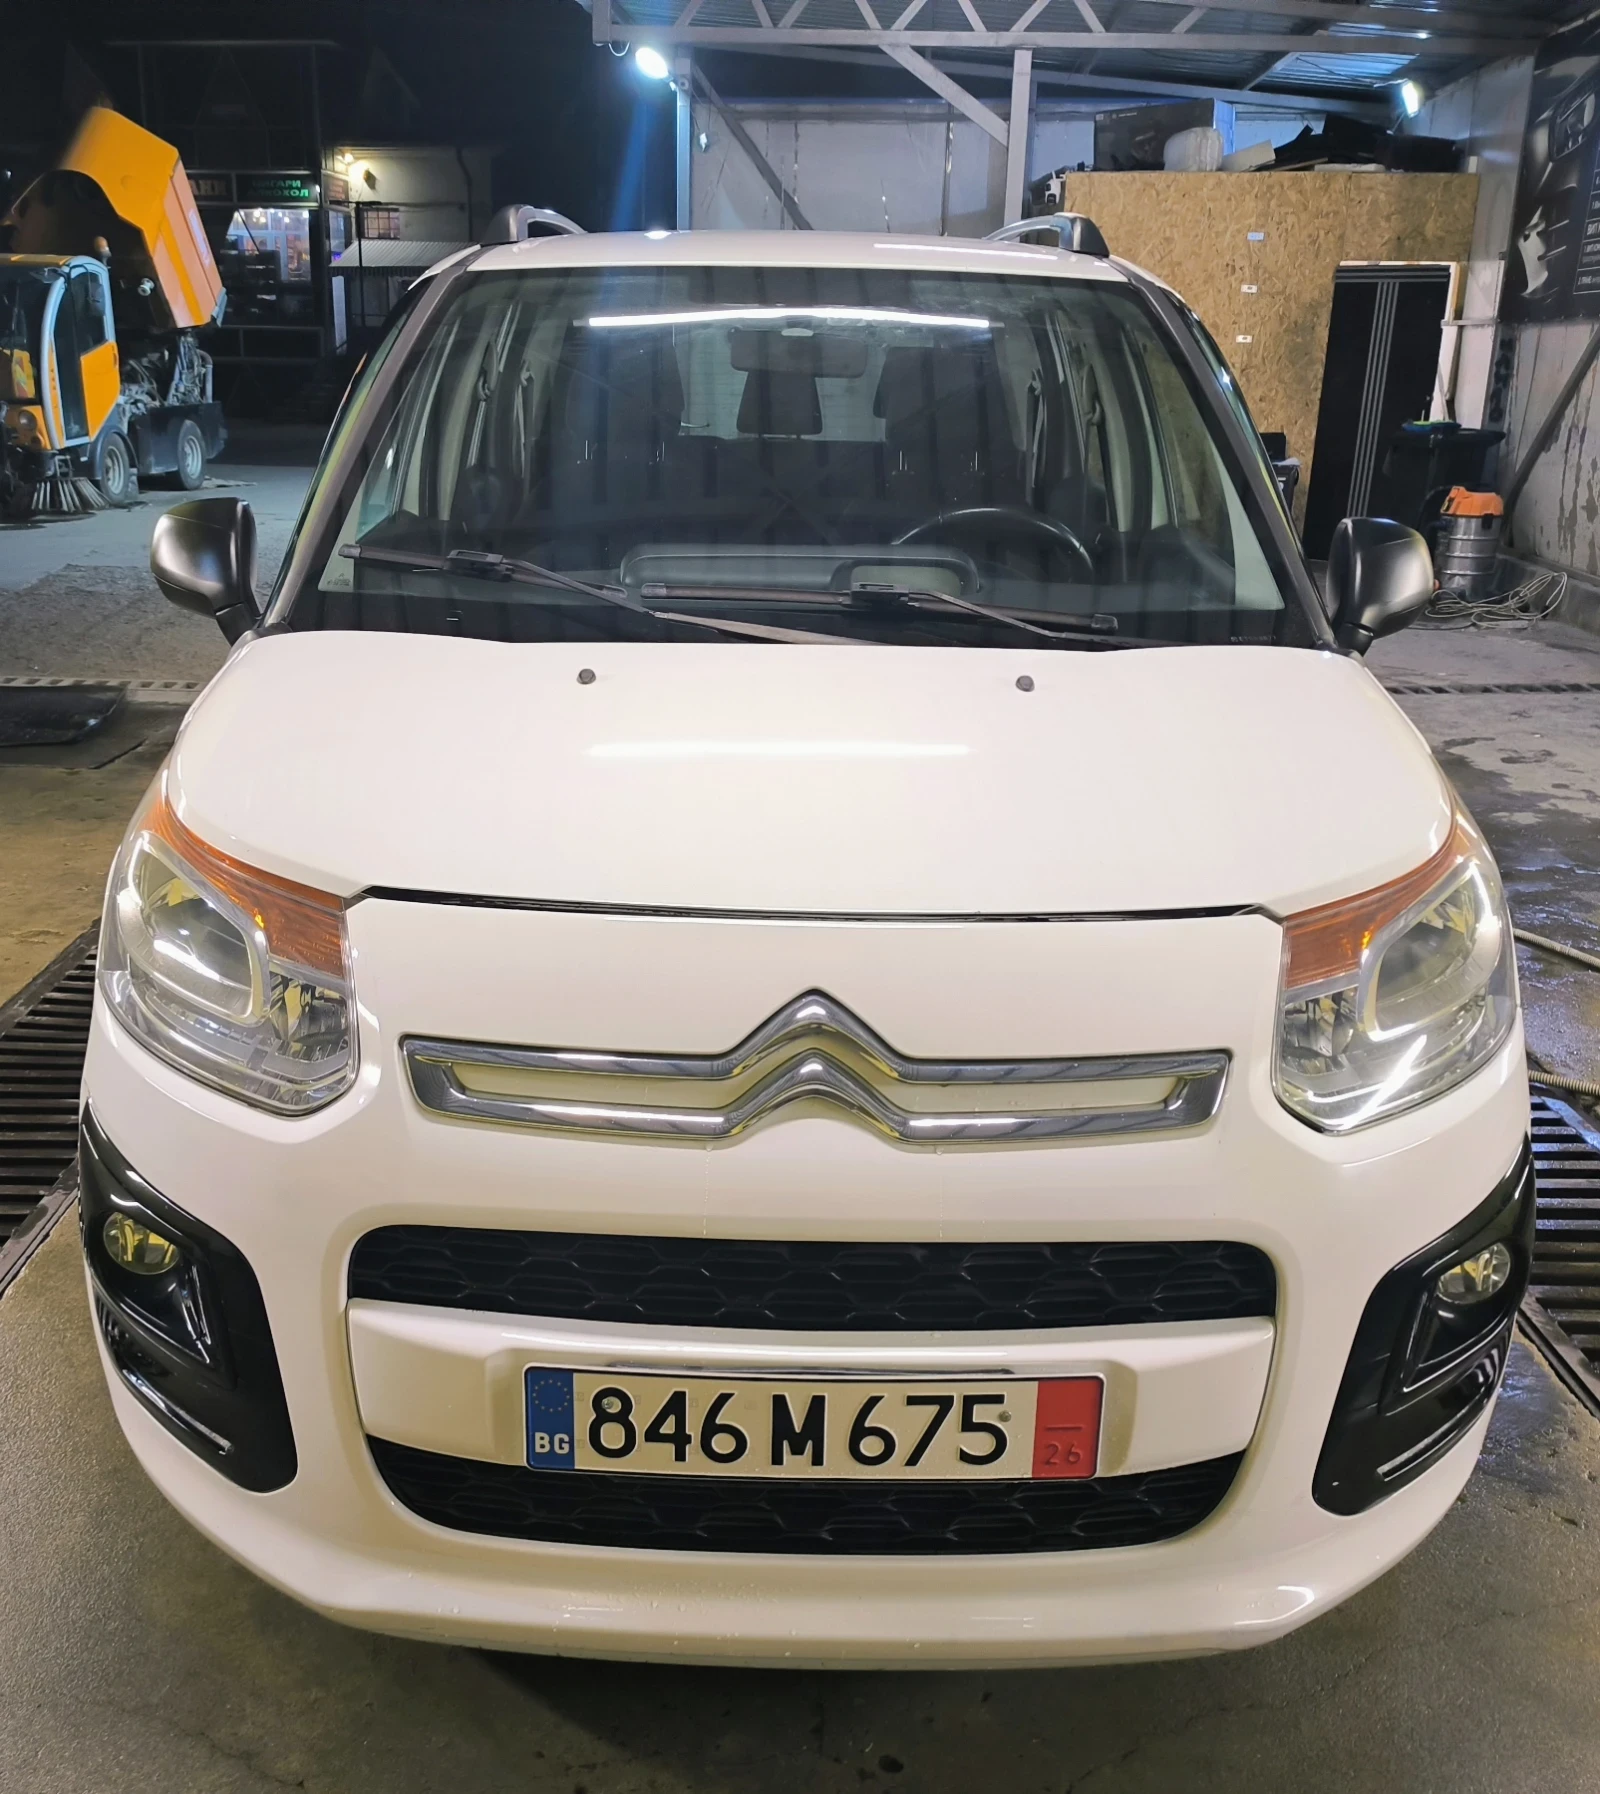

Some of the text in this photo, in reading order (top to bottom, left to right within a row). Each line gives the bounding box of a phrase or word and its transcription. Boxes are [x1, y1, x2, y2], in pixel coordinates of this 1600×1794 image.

[589, 1386, 1008, 1467] 846 M 675
[535, 1431, 570, 1454] BG
[1043, 1441, 1083, 1466] 26
